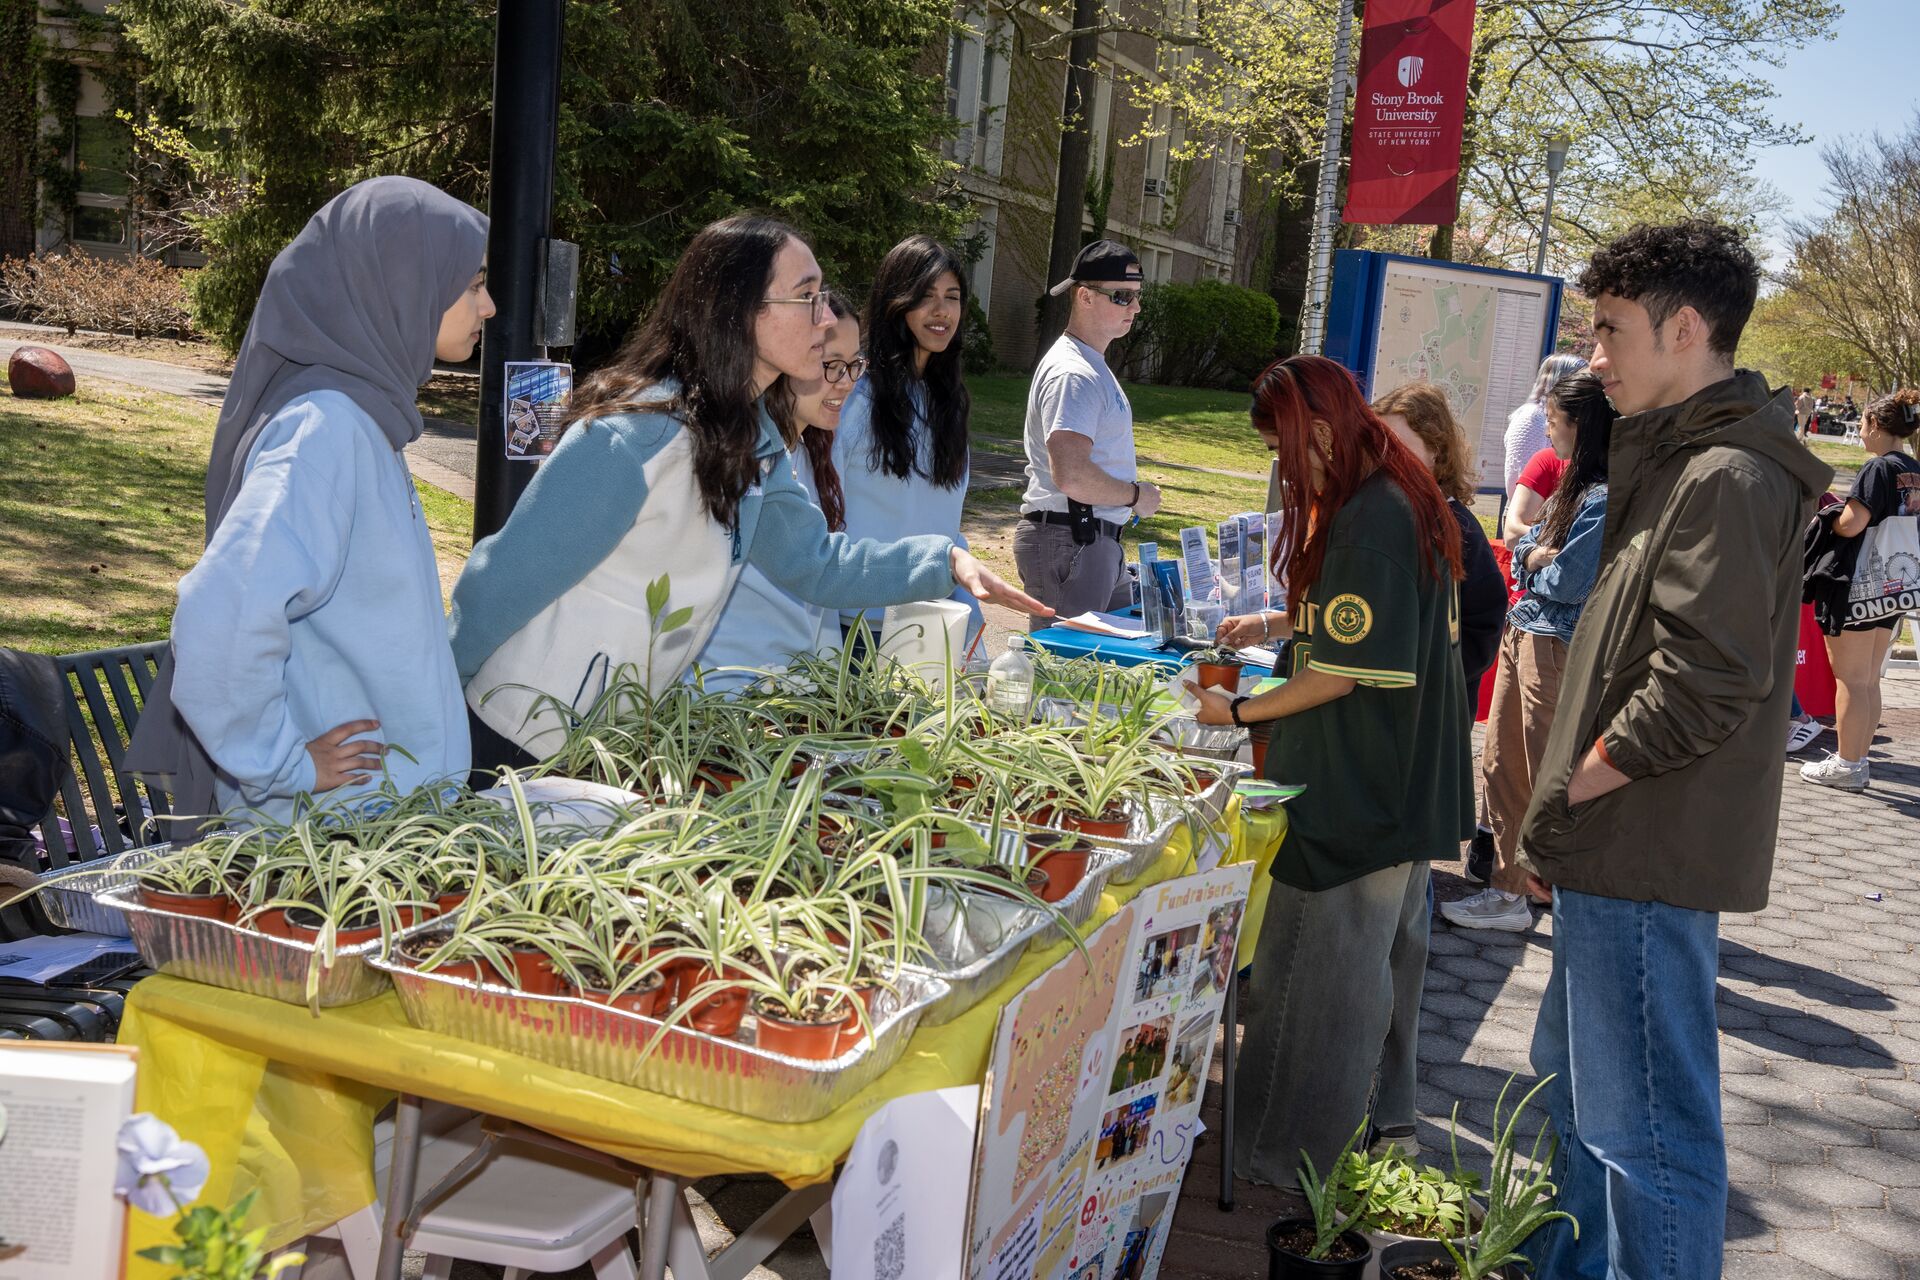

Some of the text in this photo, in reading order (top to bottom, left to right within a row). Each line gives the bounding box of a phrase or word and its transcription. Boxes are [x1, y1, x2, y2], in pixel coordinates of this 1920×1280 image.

[1371, 91, 1444, 107] Stony Brook
[1376, 108, 1437, 123] University
[1845, 589, 1920, 621] ONDO
[1156, 881, 1234, 912] Fundraisers
